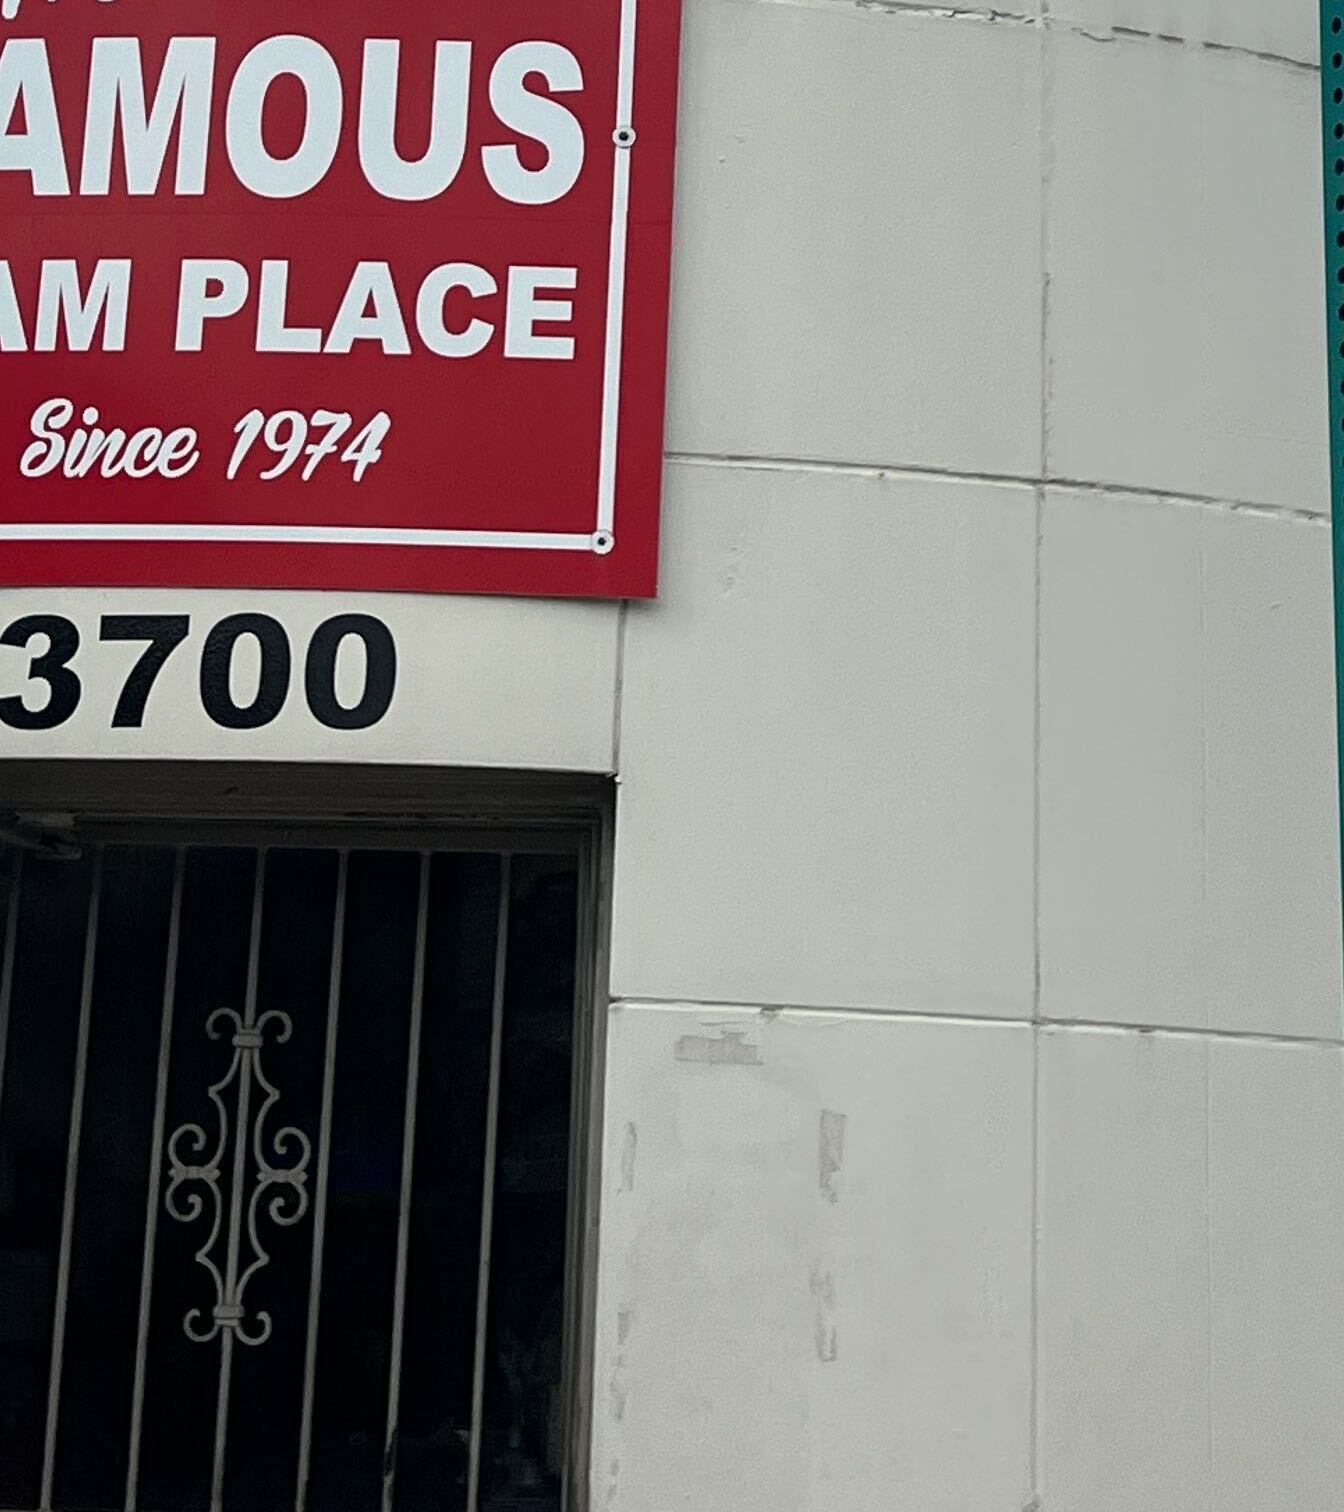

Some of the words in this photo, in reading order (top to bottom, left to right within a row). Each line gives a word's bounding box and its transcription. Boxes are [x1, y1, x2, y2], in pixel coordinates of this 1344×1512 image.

[173, 257, 579, 361] PLACE
[18, 397, 201, 480] Since
[225, 408, 393, 483] 1974
